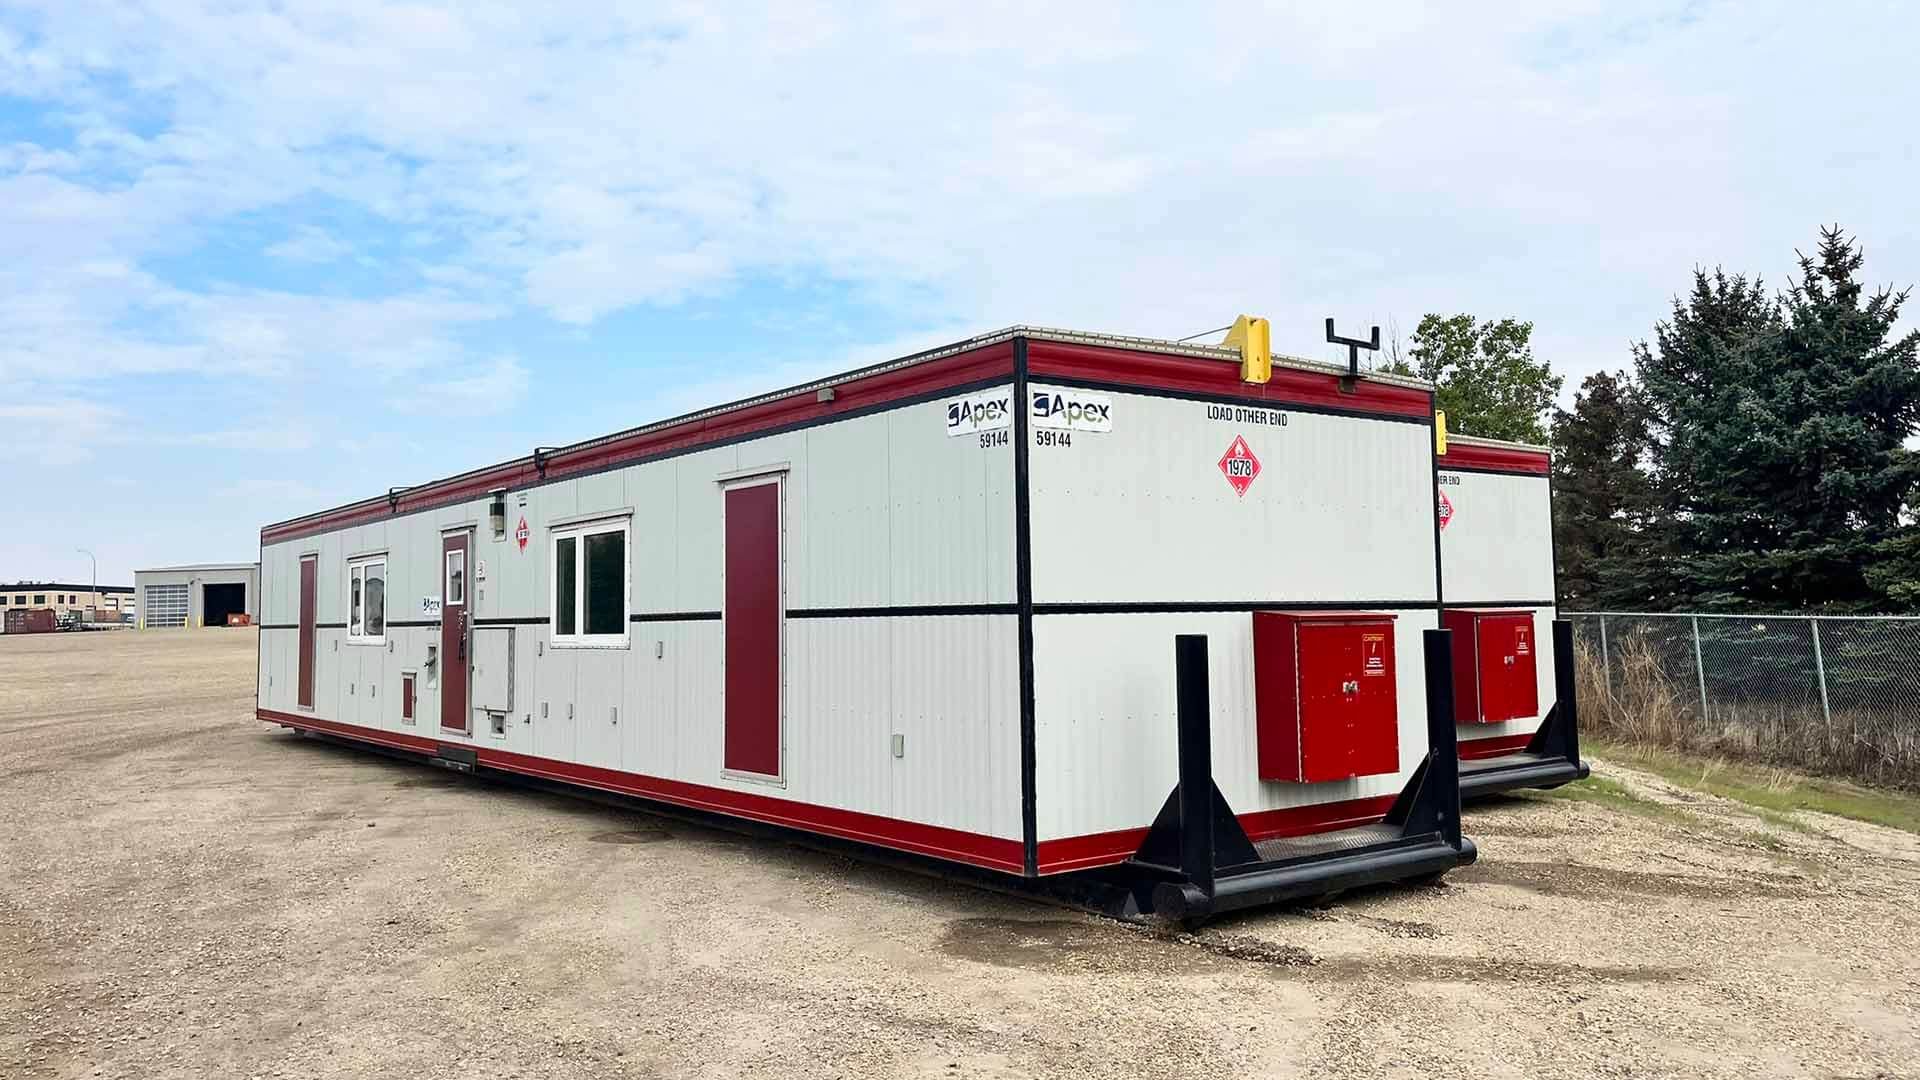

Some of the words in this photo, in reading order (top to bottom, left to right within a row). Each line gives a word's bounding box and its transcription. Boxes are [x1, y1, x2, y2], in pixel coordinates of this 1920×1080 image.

[960, 399, 1008, 428] Apex
[1051, 394, 1110, 425] Apex
[1207, 405, 1233, 421] LOAD
[1235, 408, 1267, 424] OTHER
[1269, 412, 1288, 426] END
[980, 431, 1008, 448] 59144
[1036, 431, 1071, 447] 59144
[1228, 459, 1252, 476] 1978
[1449, 475, 1460, 485] END
